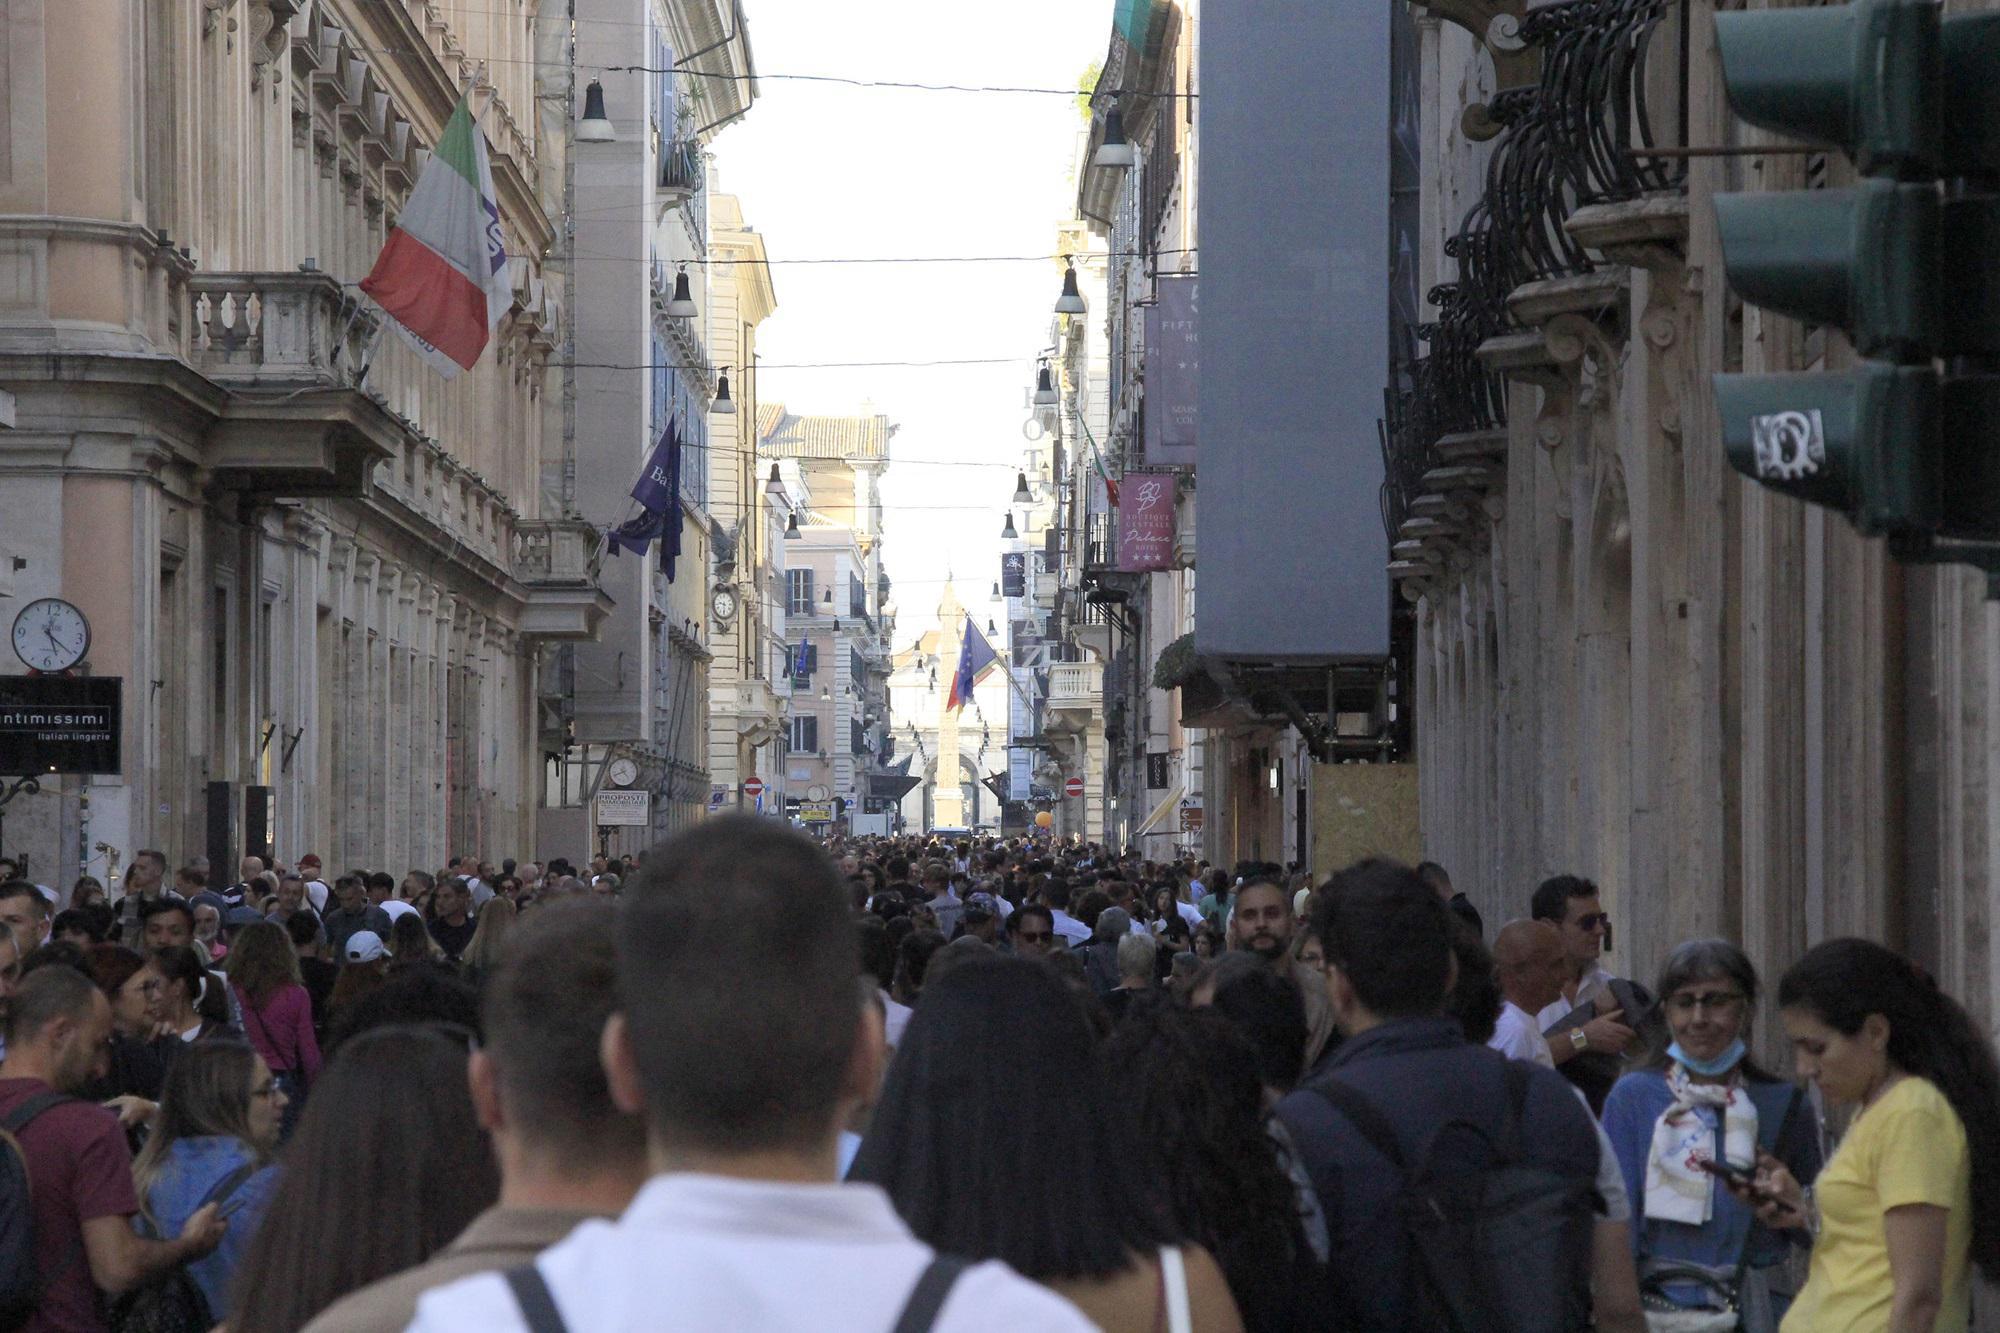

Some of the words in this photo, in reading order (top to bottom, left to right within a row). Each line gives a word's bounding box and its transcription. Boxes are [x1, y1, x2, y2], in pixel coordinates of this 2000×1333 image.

[1162, 320, 1198, 332] FIFT
[650, 464, 668, 487] Ba
[47, 604, 61, 617] 12
[18, 627, 26, 639] 9
[76, 633, 83, 644] 3
[43, 656, 52, 667] 6
[2, 712, 103, 724] ntimissimi
[38, 732, 69, 740] Italian
[73, 732, 111, 742] lingerie
